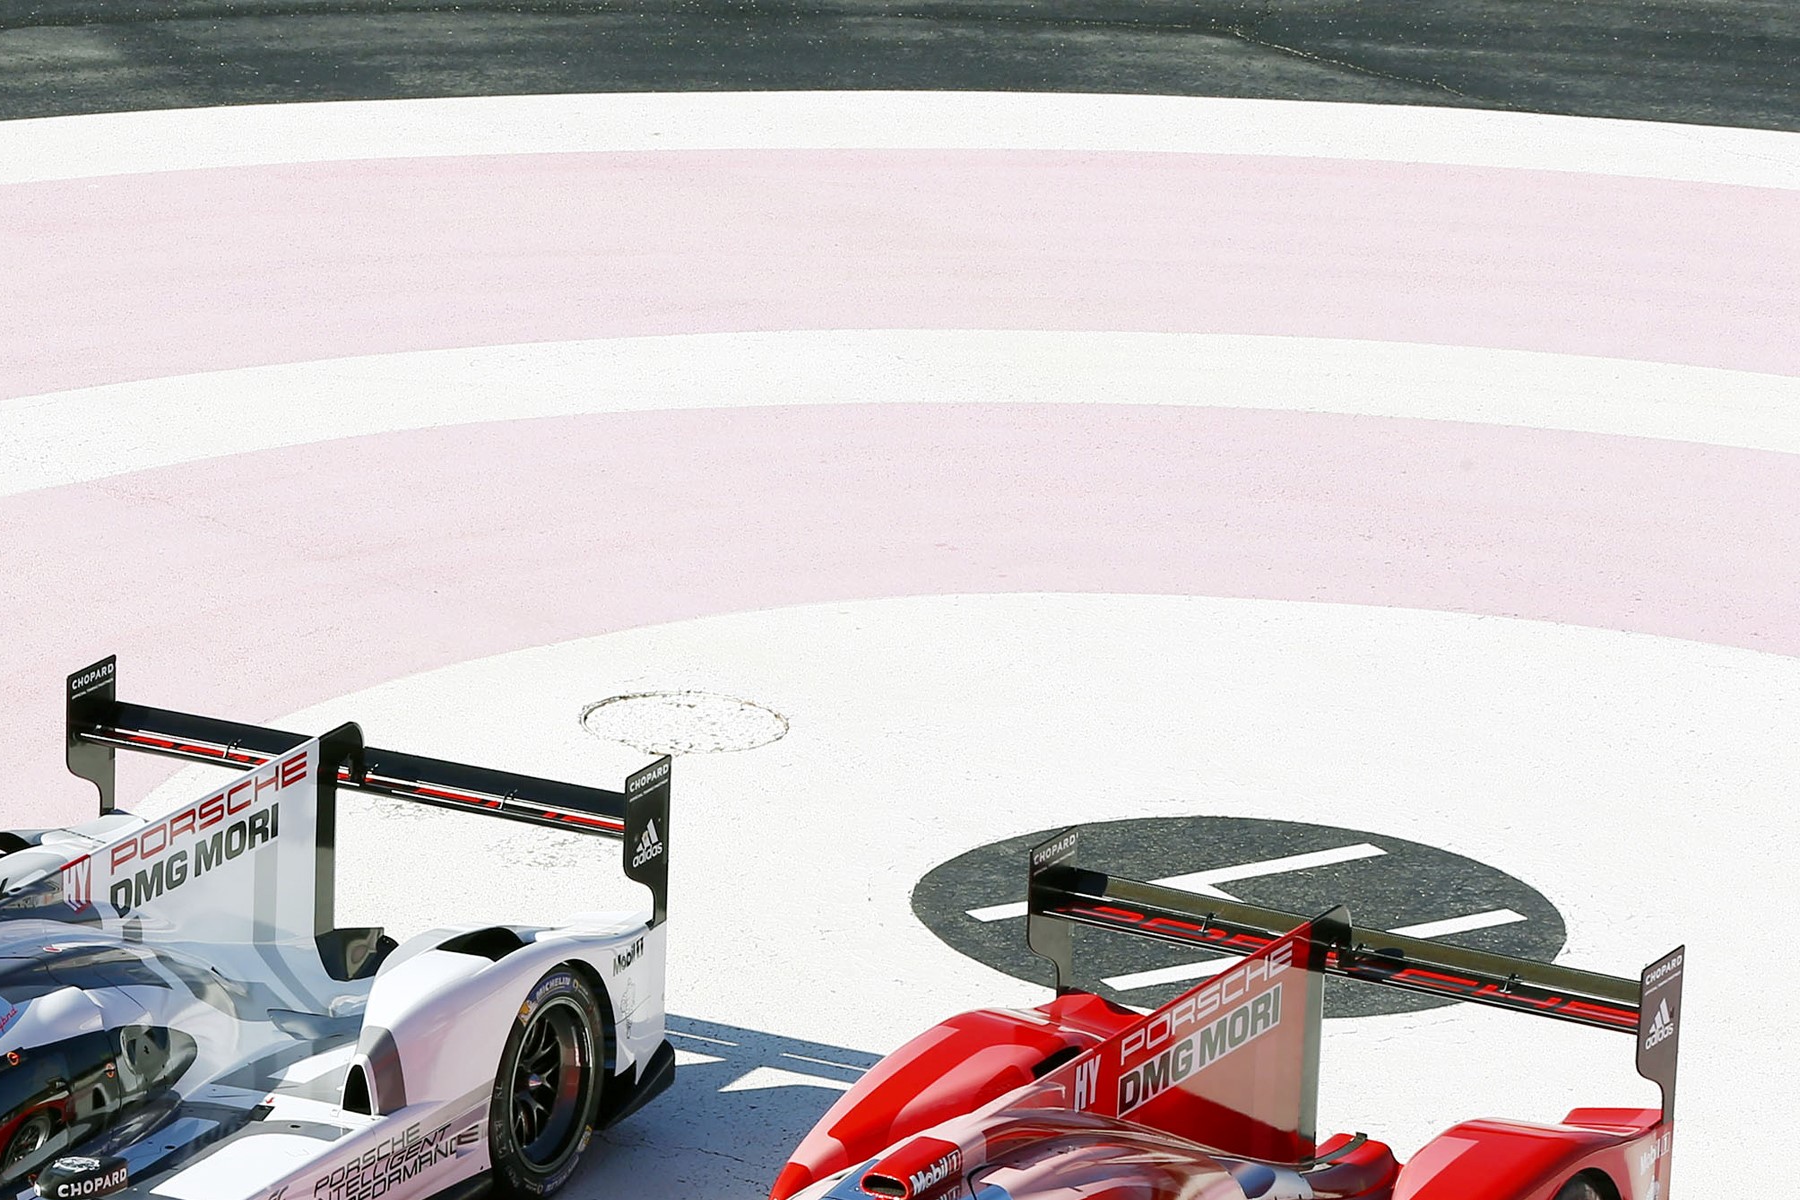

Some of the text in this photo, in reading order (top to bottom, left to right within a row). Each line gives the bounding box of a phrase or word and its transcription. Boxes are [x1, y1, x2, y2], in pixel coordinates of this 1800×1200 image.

[71, 663, 115, 690] CHOPARD
[629, 763, 669, 793] CHOPARD
[110, 751, 308, 876] PORSCHE
[109, 850, 188, 919] DMG
[194, 802, 279, 878] MORI
[632, 841, 663, 868] adidas
[1033, 834, 1077, 866] CHOPARD
[1645, 954, 1683, 985] CHOPARD
[536, 976, 571, 1001] MICHELIN
[1120, 941, 1293, 1066] PORSCHE
[1119, 982, 1282, 1118] DMG MORI
[1645, 1022, 1674, 1050] adidas
[1074, 1054, 1101, 1112] HY
[313, 1121, 421, 1198] PORSCHE
[57, 1167, 127, 1198] CHOPARD
[909, 1156, 948, 1197] Mobil
